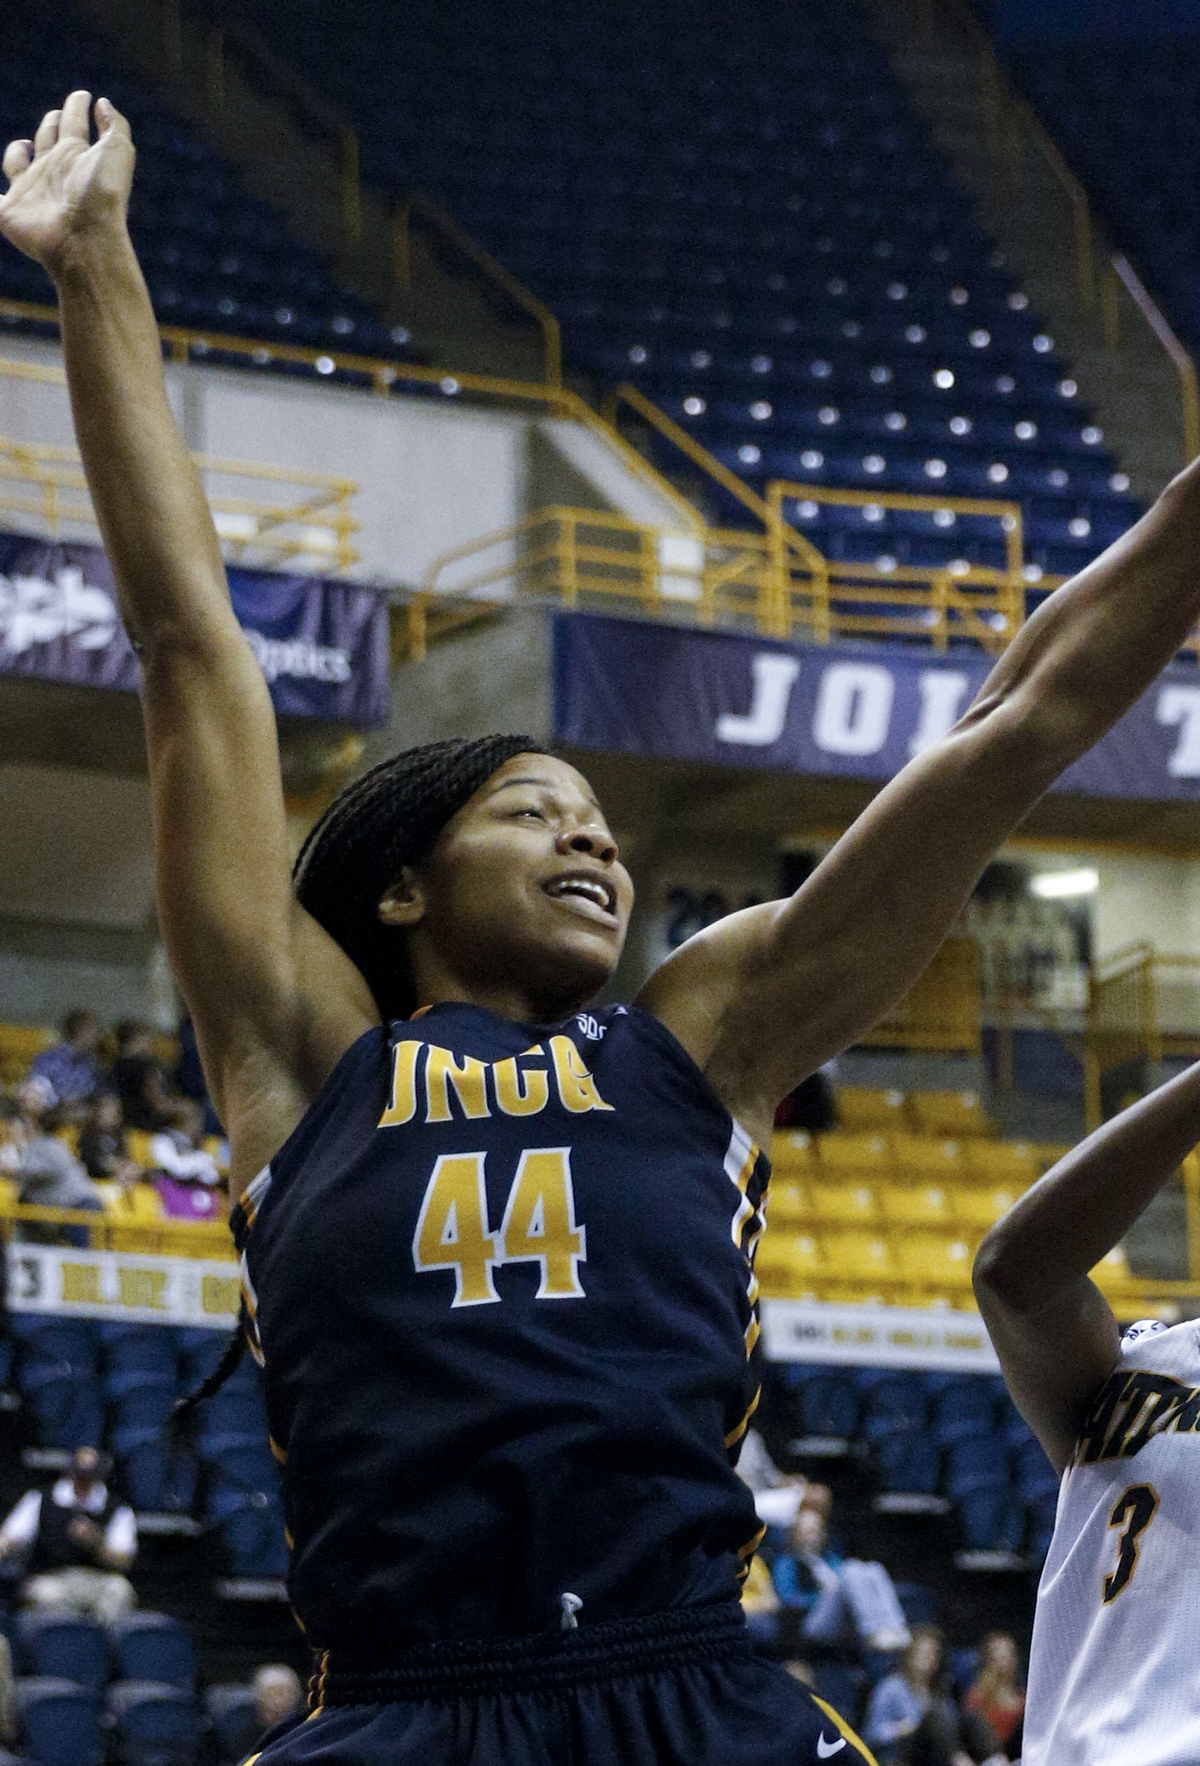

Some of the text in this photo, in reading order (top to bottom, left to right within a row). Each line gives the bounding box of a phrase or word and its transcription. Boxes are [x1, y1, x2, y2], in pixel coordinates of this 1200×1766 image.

[715, 652, 970, 758] JOI
[411, 1146, 588, 1308] 44
[1103, 1482, 1160, 1606] 3
